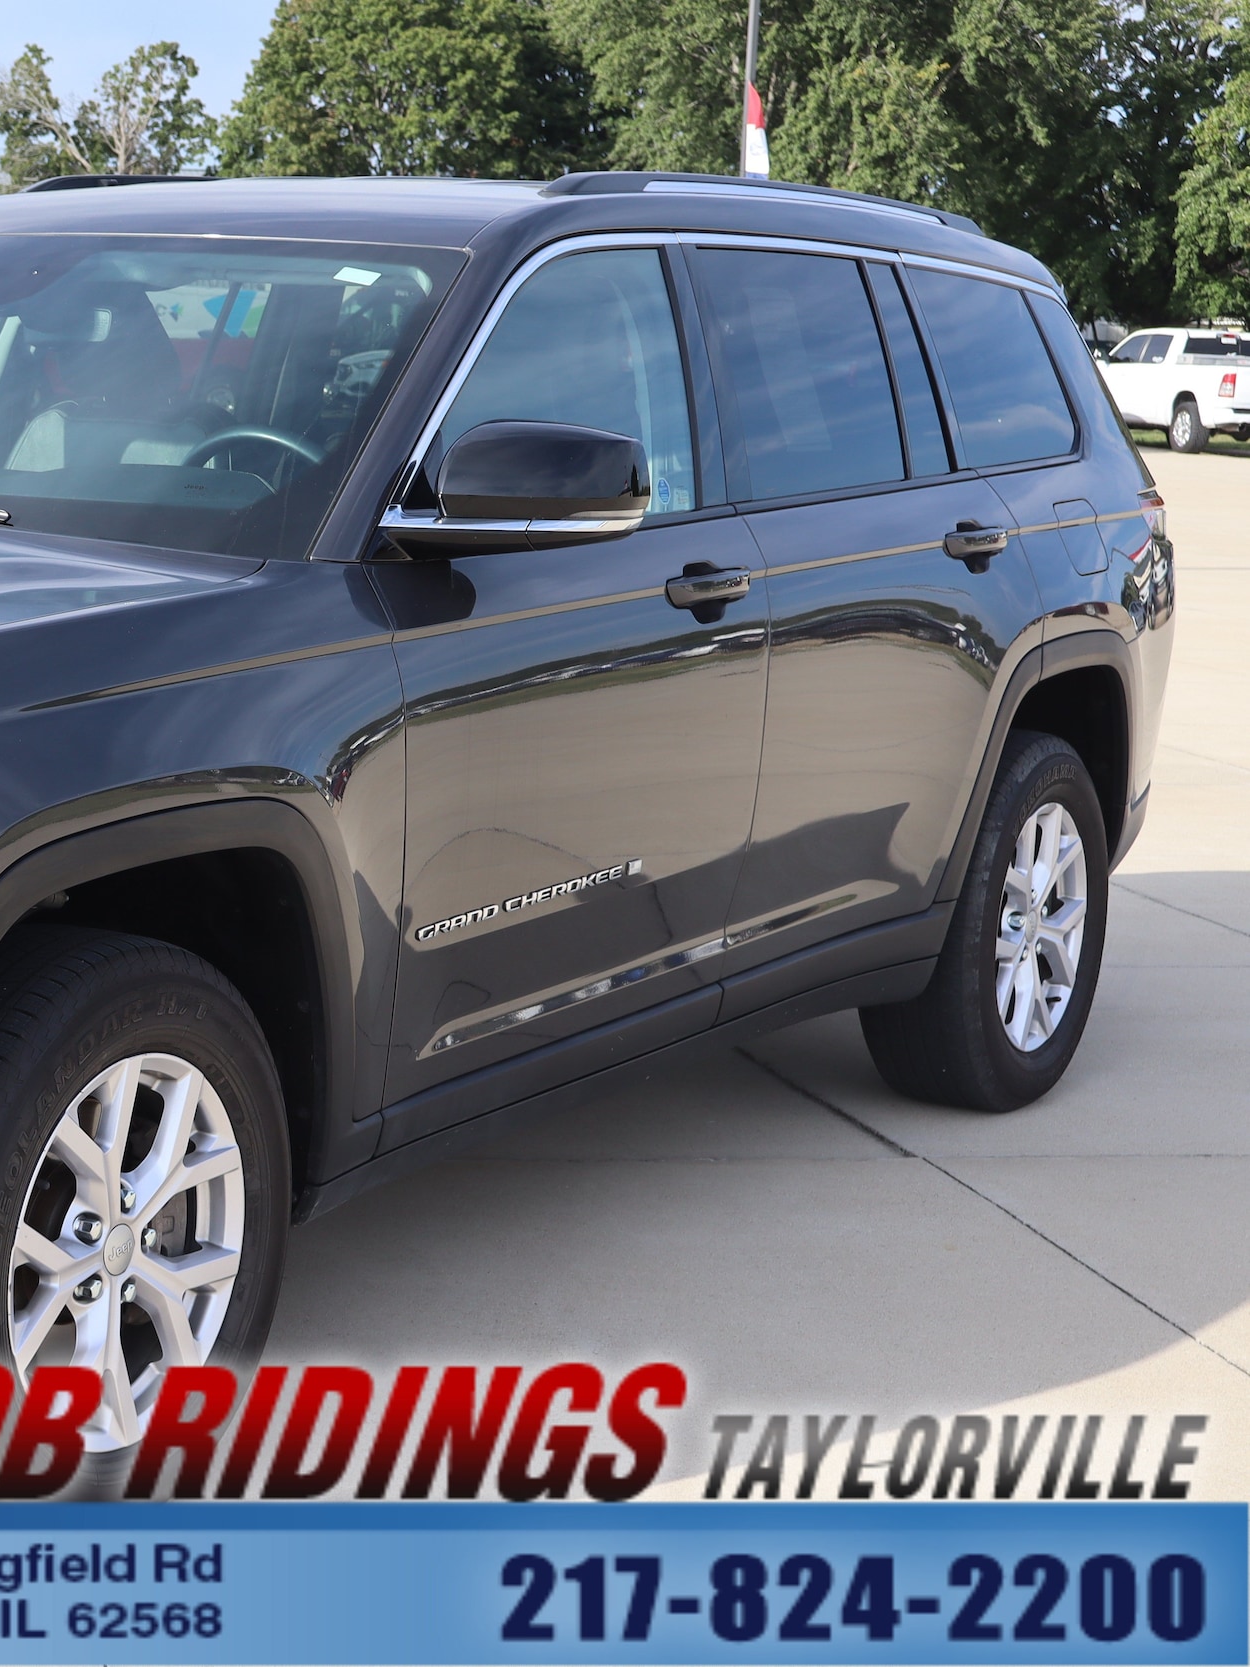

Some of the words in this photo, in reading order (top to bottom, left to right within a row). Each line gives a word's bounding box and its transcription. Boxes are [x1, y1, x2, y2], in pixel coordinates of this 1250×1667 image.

[416, 904, 499, 942] GRAND
[503, 865, 623, 913] CHEROKEE
[108, 1239, 133, 1261] Jeep
